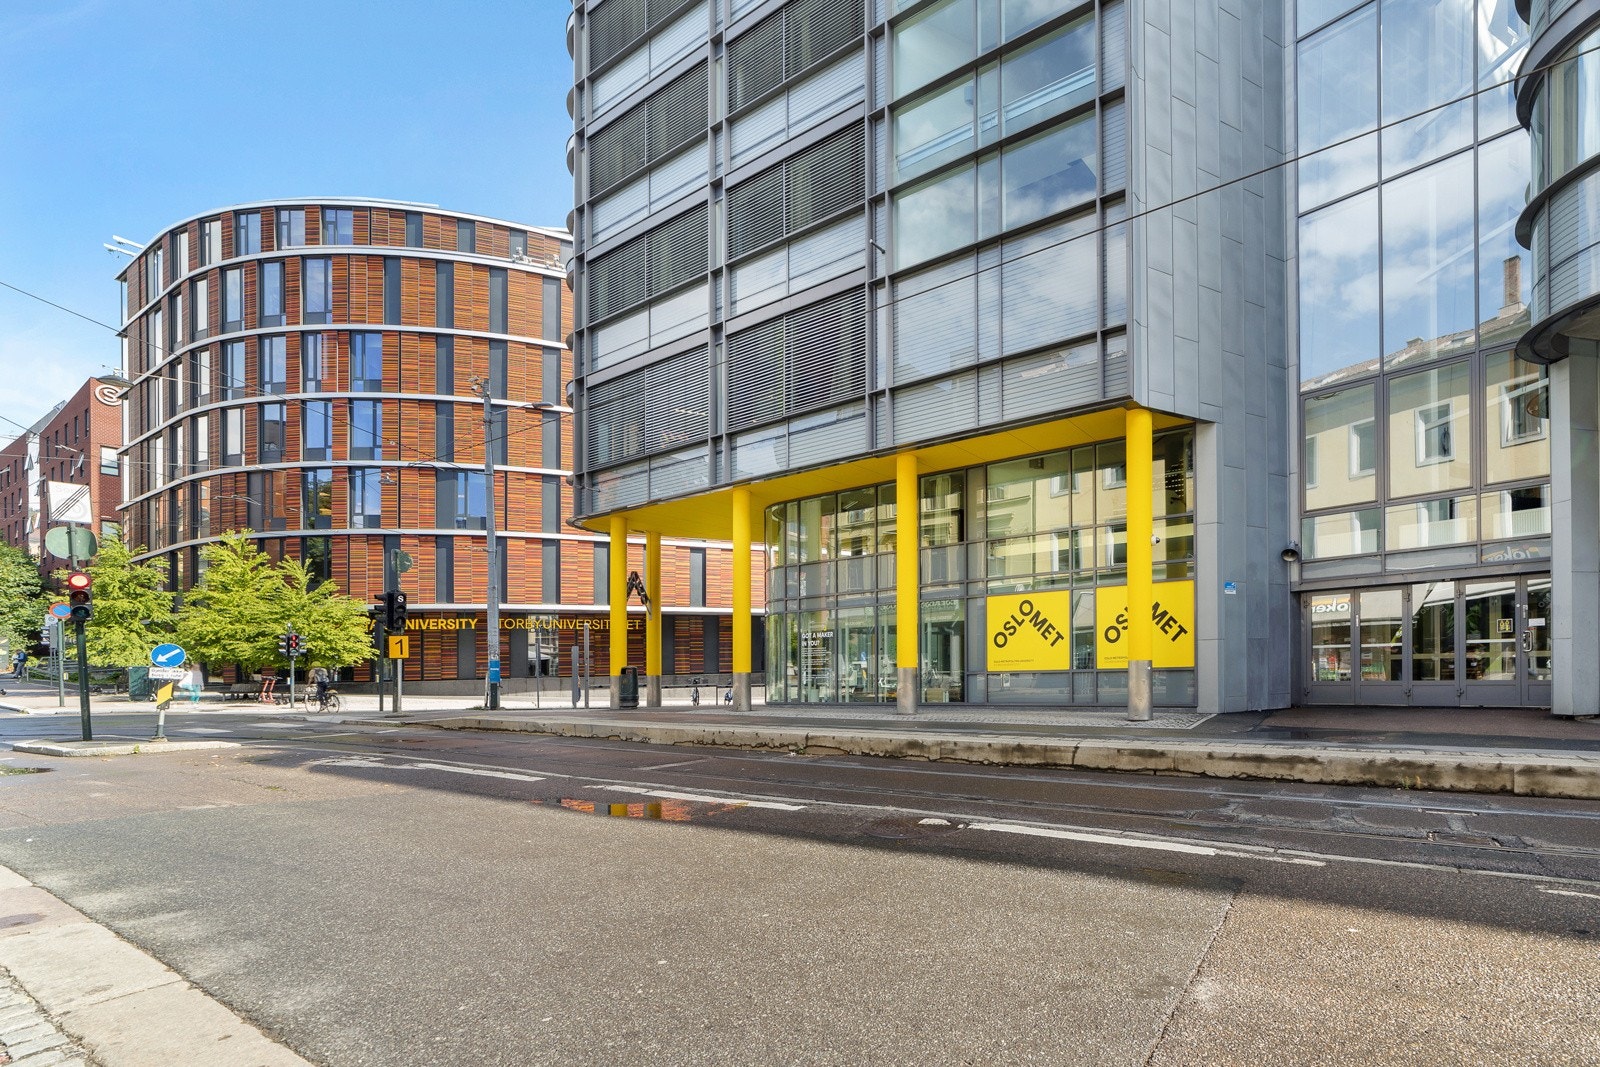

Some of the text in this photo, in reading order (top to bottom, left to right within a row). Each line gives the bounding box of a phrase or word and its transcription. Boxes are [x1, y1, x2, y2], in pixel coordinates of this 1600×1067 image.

[385, 618, 478, 630] NIVERSITY
[993, 599, 1065, 648] OSLOMET
[1104, 601, 1188, 643] OSMET
[395, 638, 403, 655] 1
